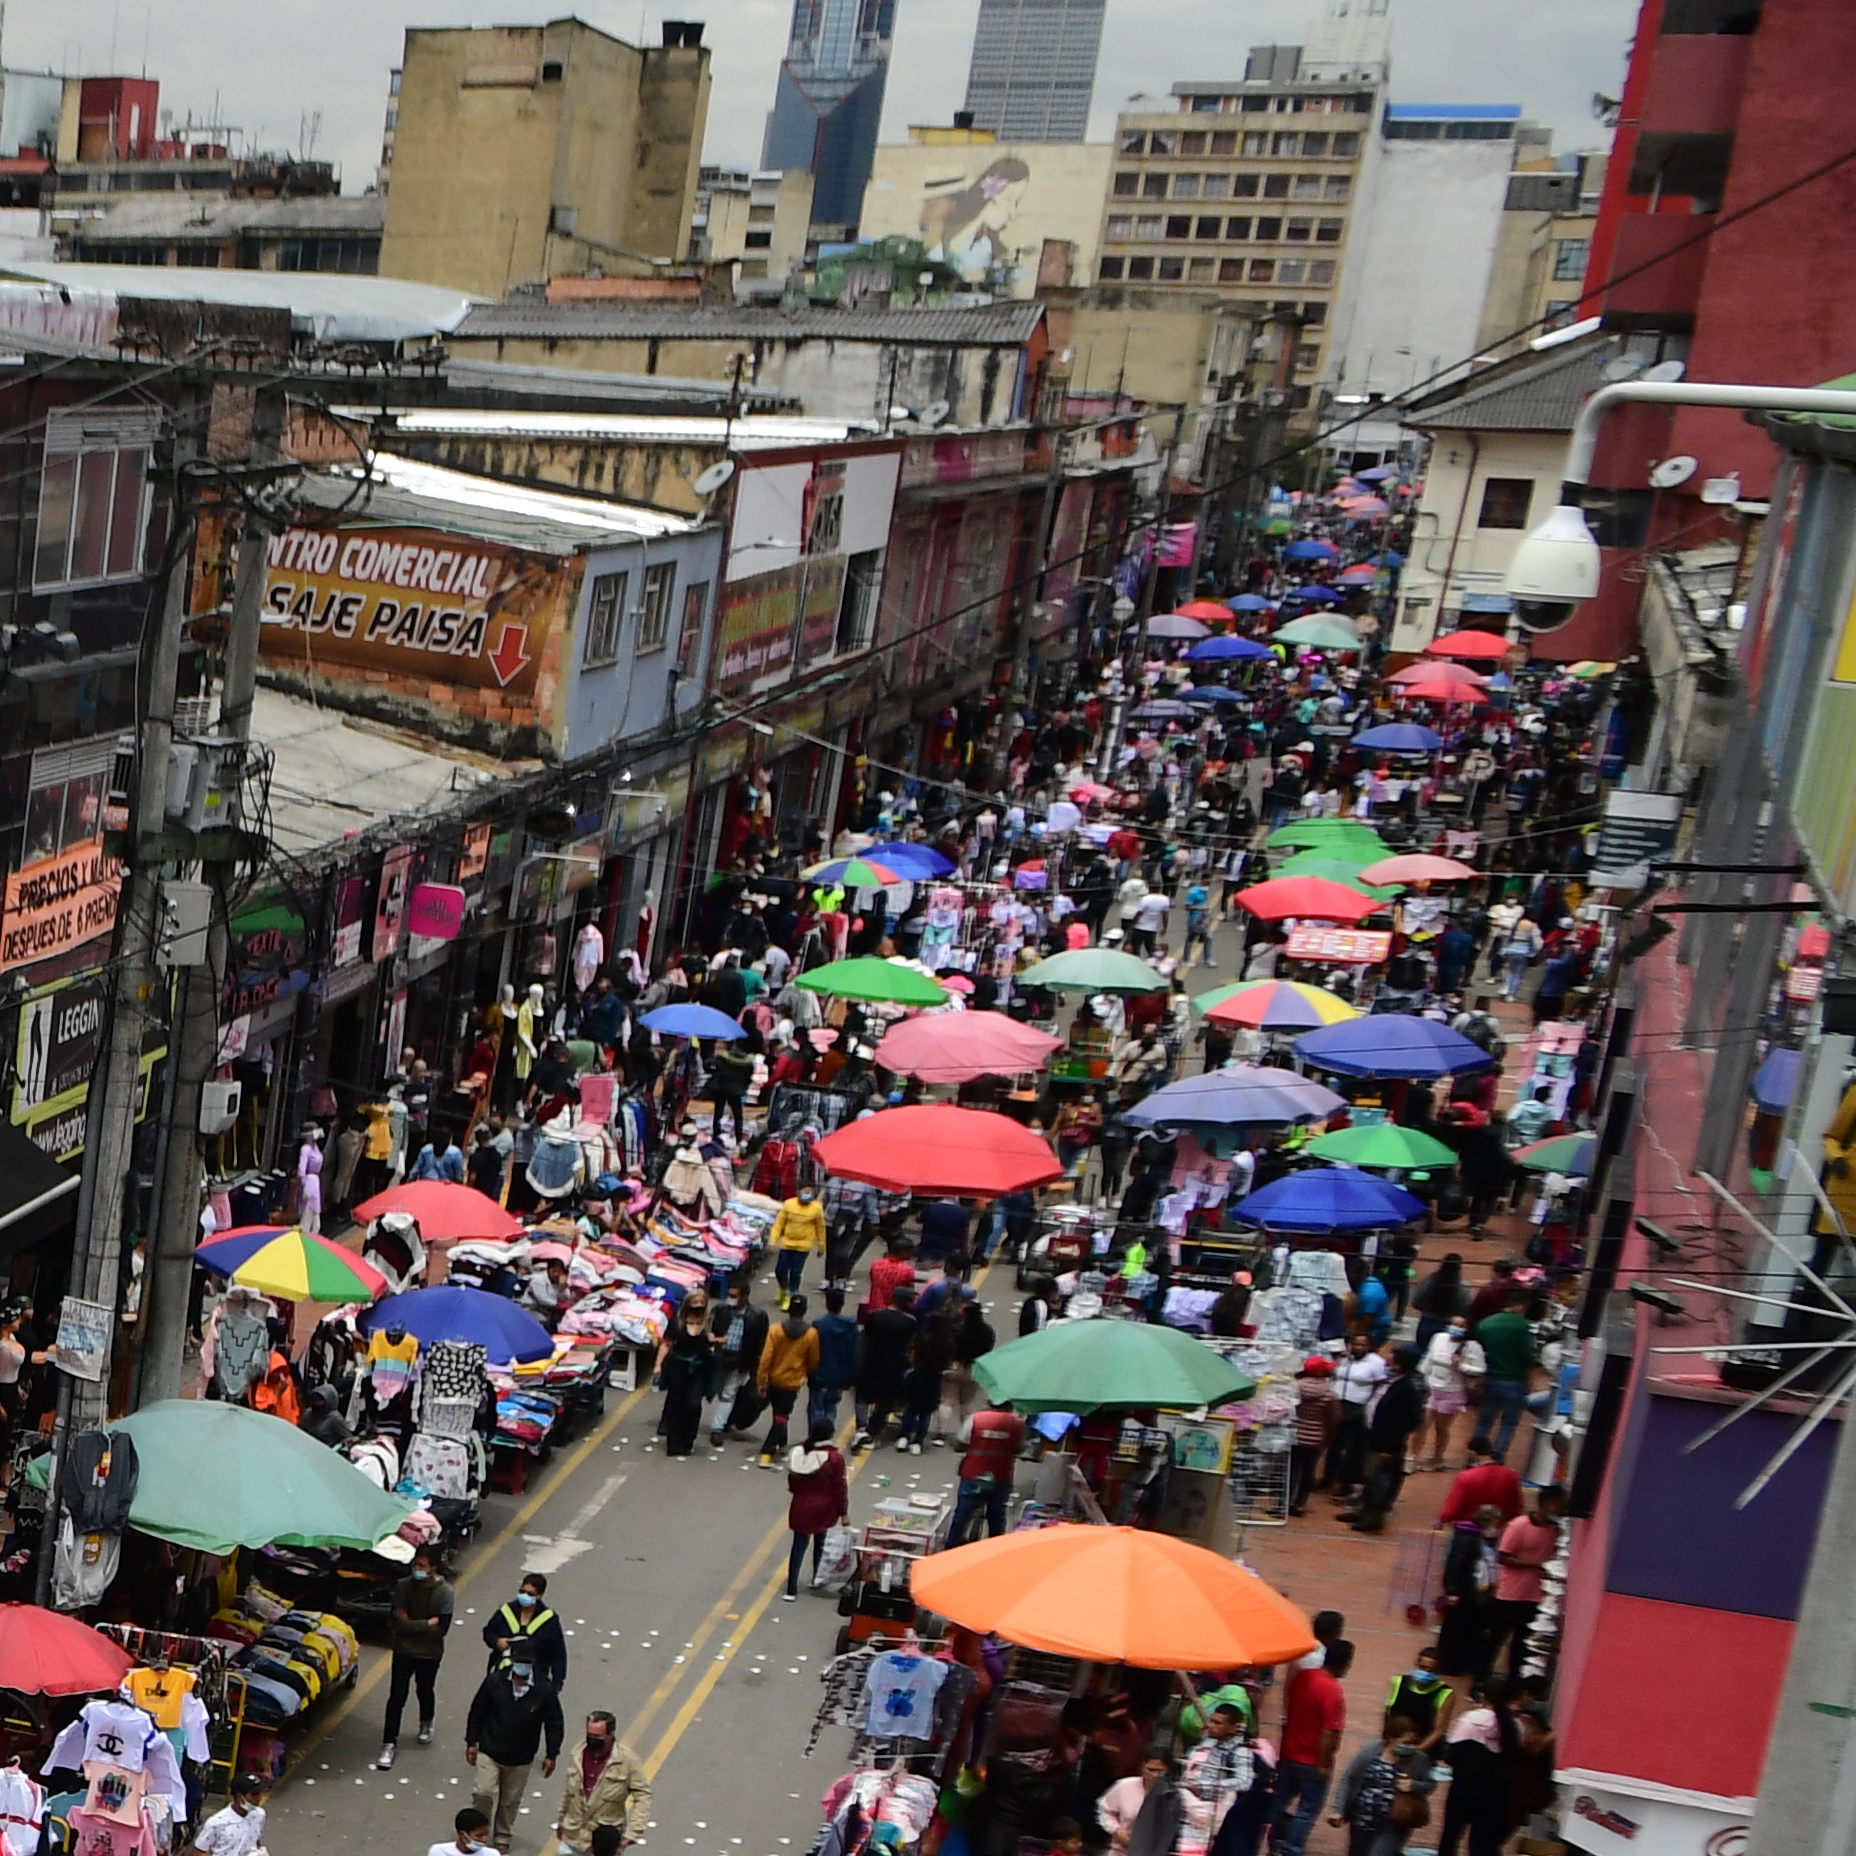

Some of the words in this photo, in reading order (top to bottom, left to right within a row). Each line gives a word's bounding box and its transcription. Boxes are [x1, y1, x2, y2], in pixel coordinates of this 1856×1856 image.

[231, 529, 339, 575] NTRO
[338, 536, 489, 599] COMERCIAL
[265, 582, 366, 638] SAJE
[364, 597, 489, 660] PAISA
[18, 862, 79, 916] PRECIOS
[3, 920, 57, 963] DESPUES
[57, 911, 73, 944] DE
[76, 910, 85, 936] 6
[57, 997, 100, 1045] LEGGIN
[32, 1108, 87, 1154] www.legging
